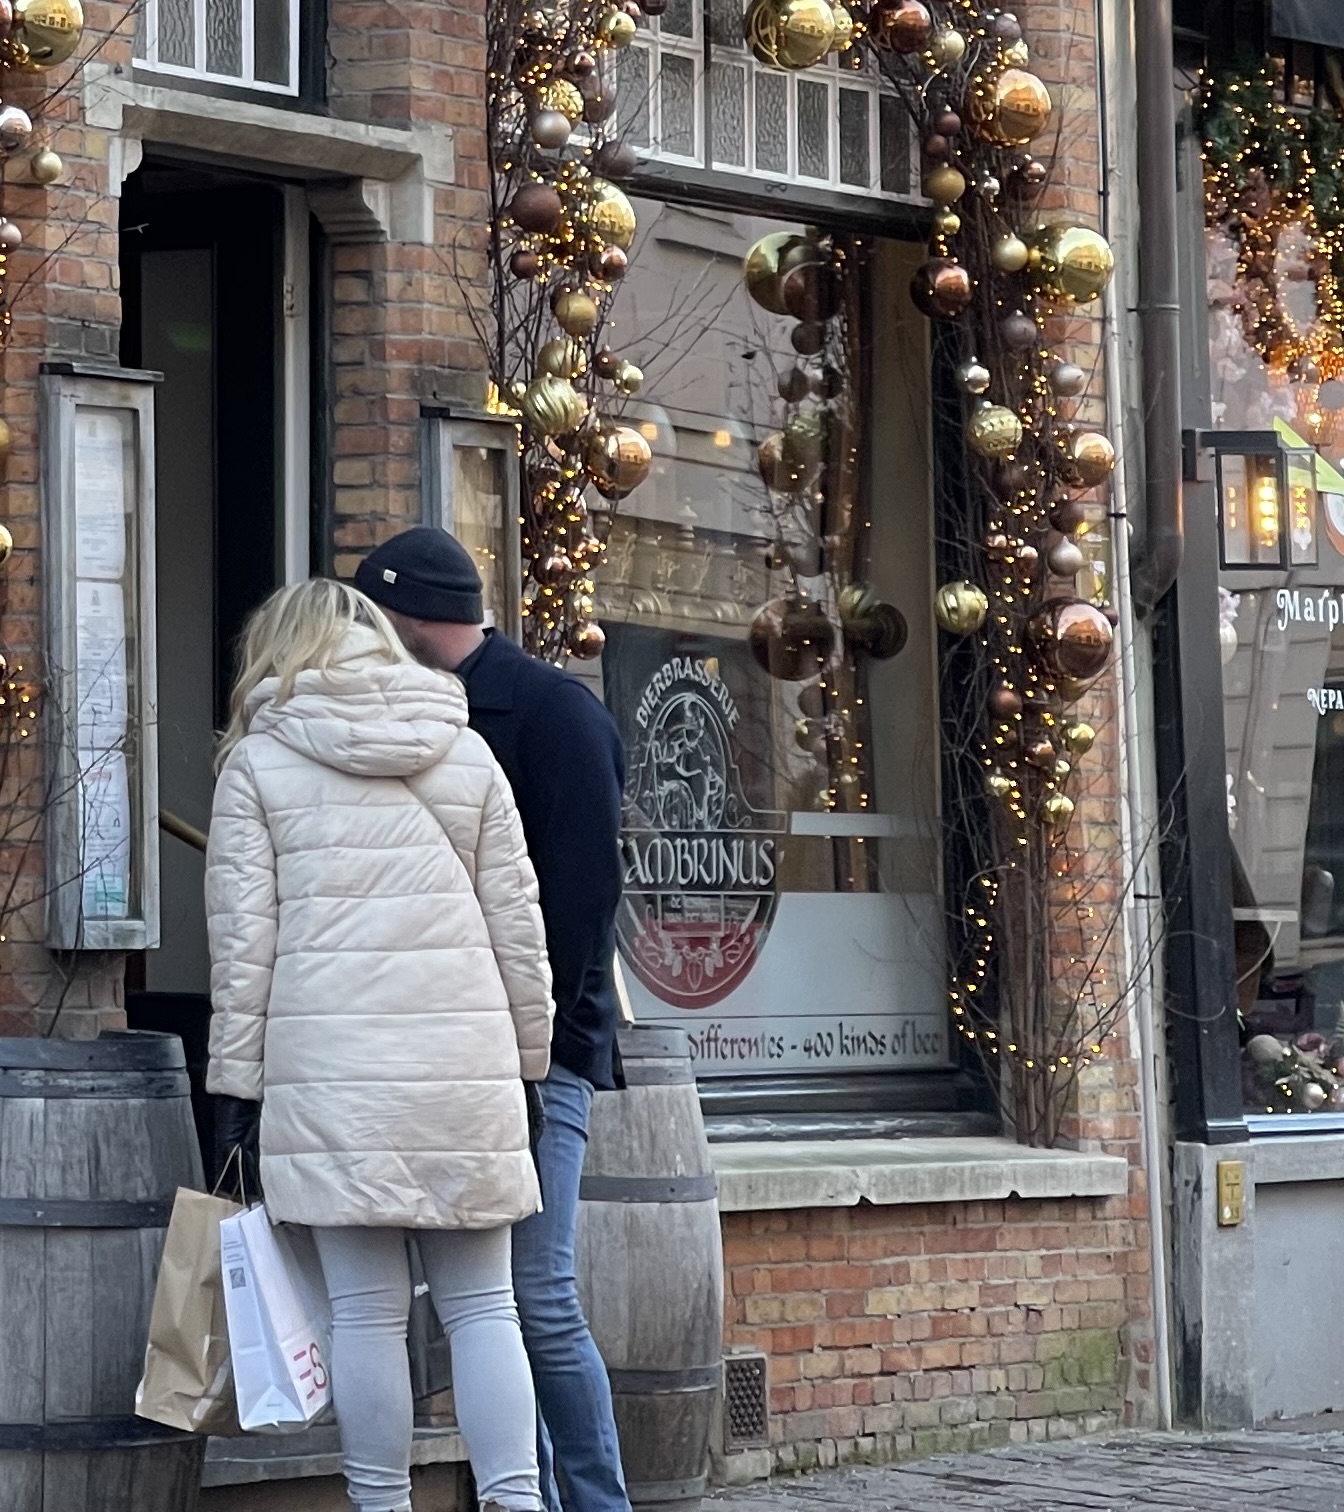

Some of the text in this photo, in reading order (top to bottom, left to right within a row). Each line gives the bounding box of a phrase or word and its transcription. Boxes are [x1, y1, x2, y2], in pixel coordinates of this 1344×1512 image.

[635, 656, 741, 731] BIERBRASSERIE
[803, 1031, 835, 1060] 400
[839, 1020, 886, 1060] kinds
[892, 1020, 910, 1056] of
